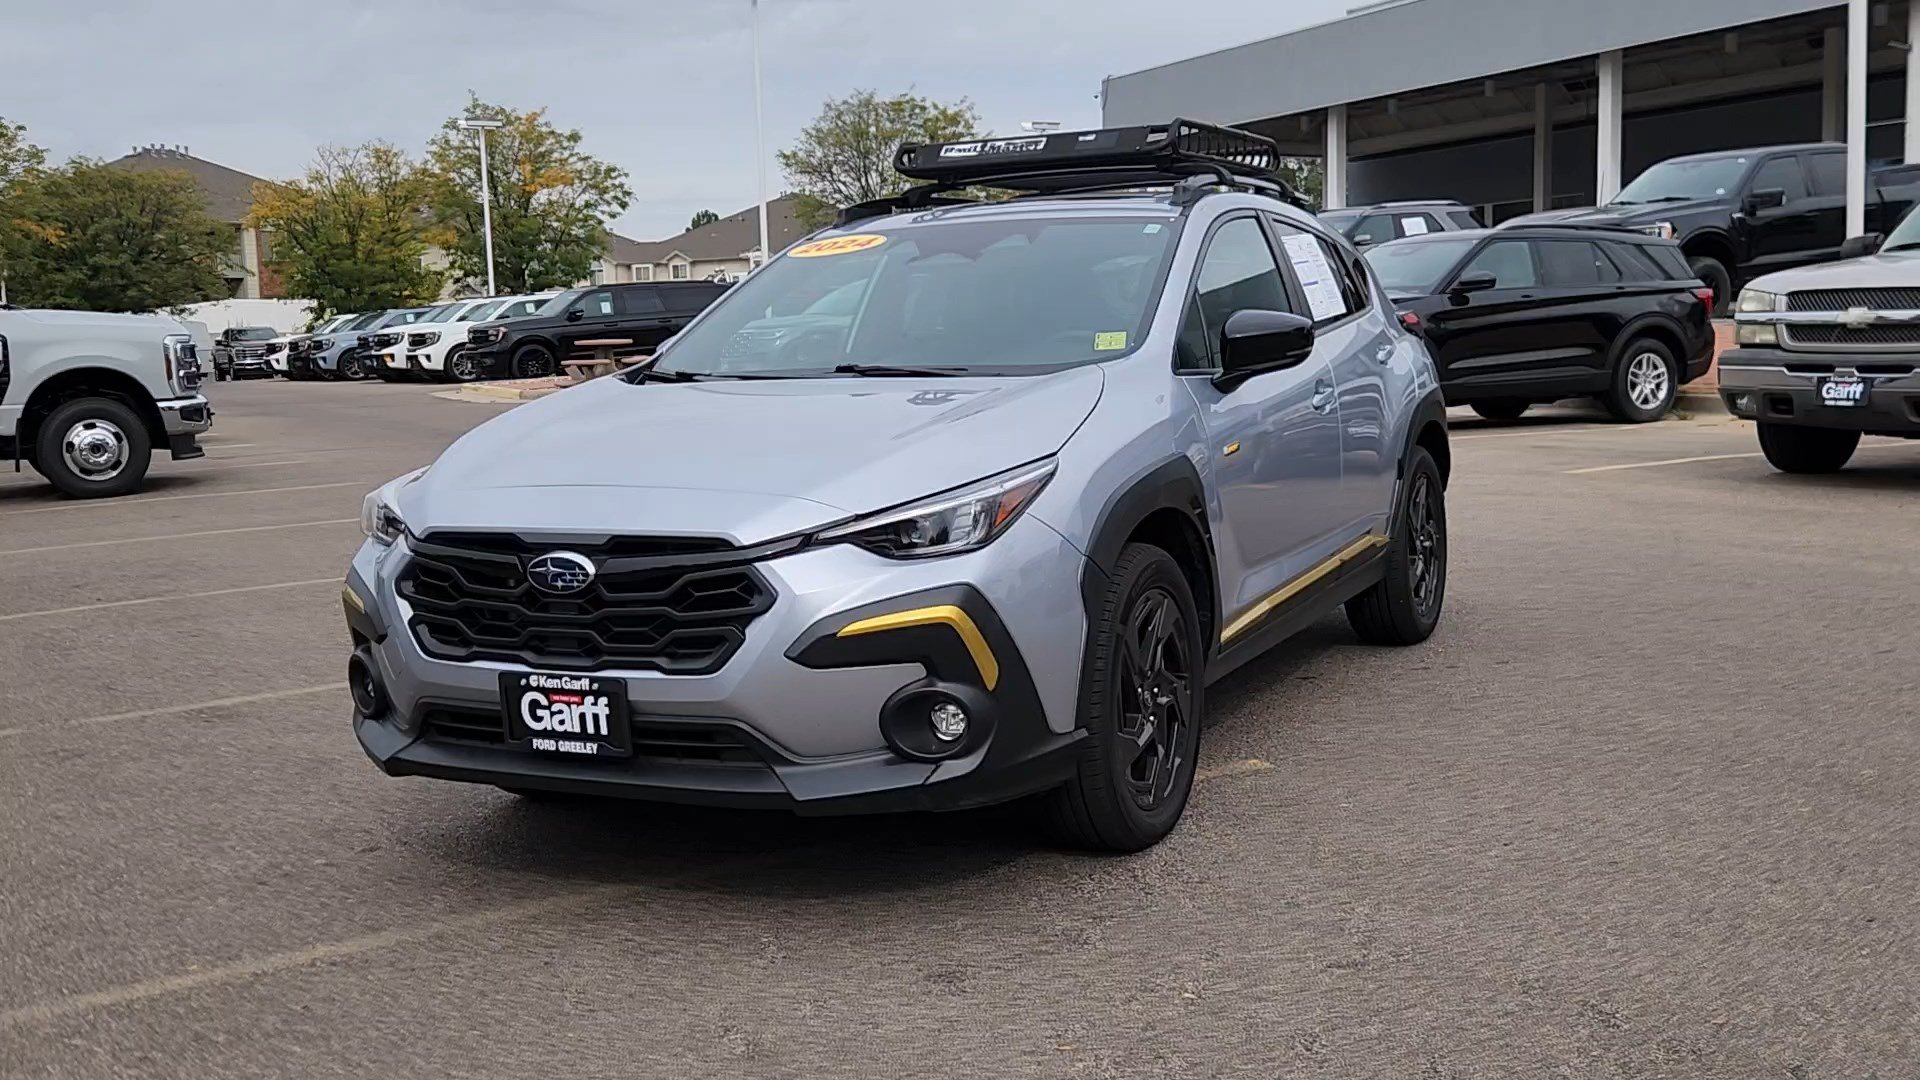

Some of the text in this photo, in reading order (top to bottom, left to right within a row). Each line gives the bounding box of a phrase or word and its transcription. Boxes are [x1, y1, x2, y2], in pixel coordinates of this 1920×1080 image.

[796, 236, 880, 254] 2024
[1822, 382, 1864, 399] Garff
[539, 675, 590, 690] Ken Garff
[520, 691, 609, 735] Garff
[532, 738, 598, 755] FORD GREELEY
